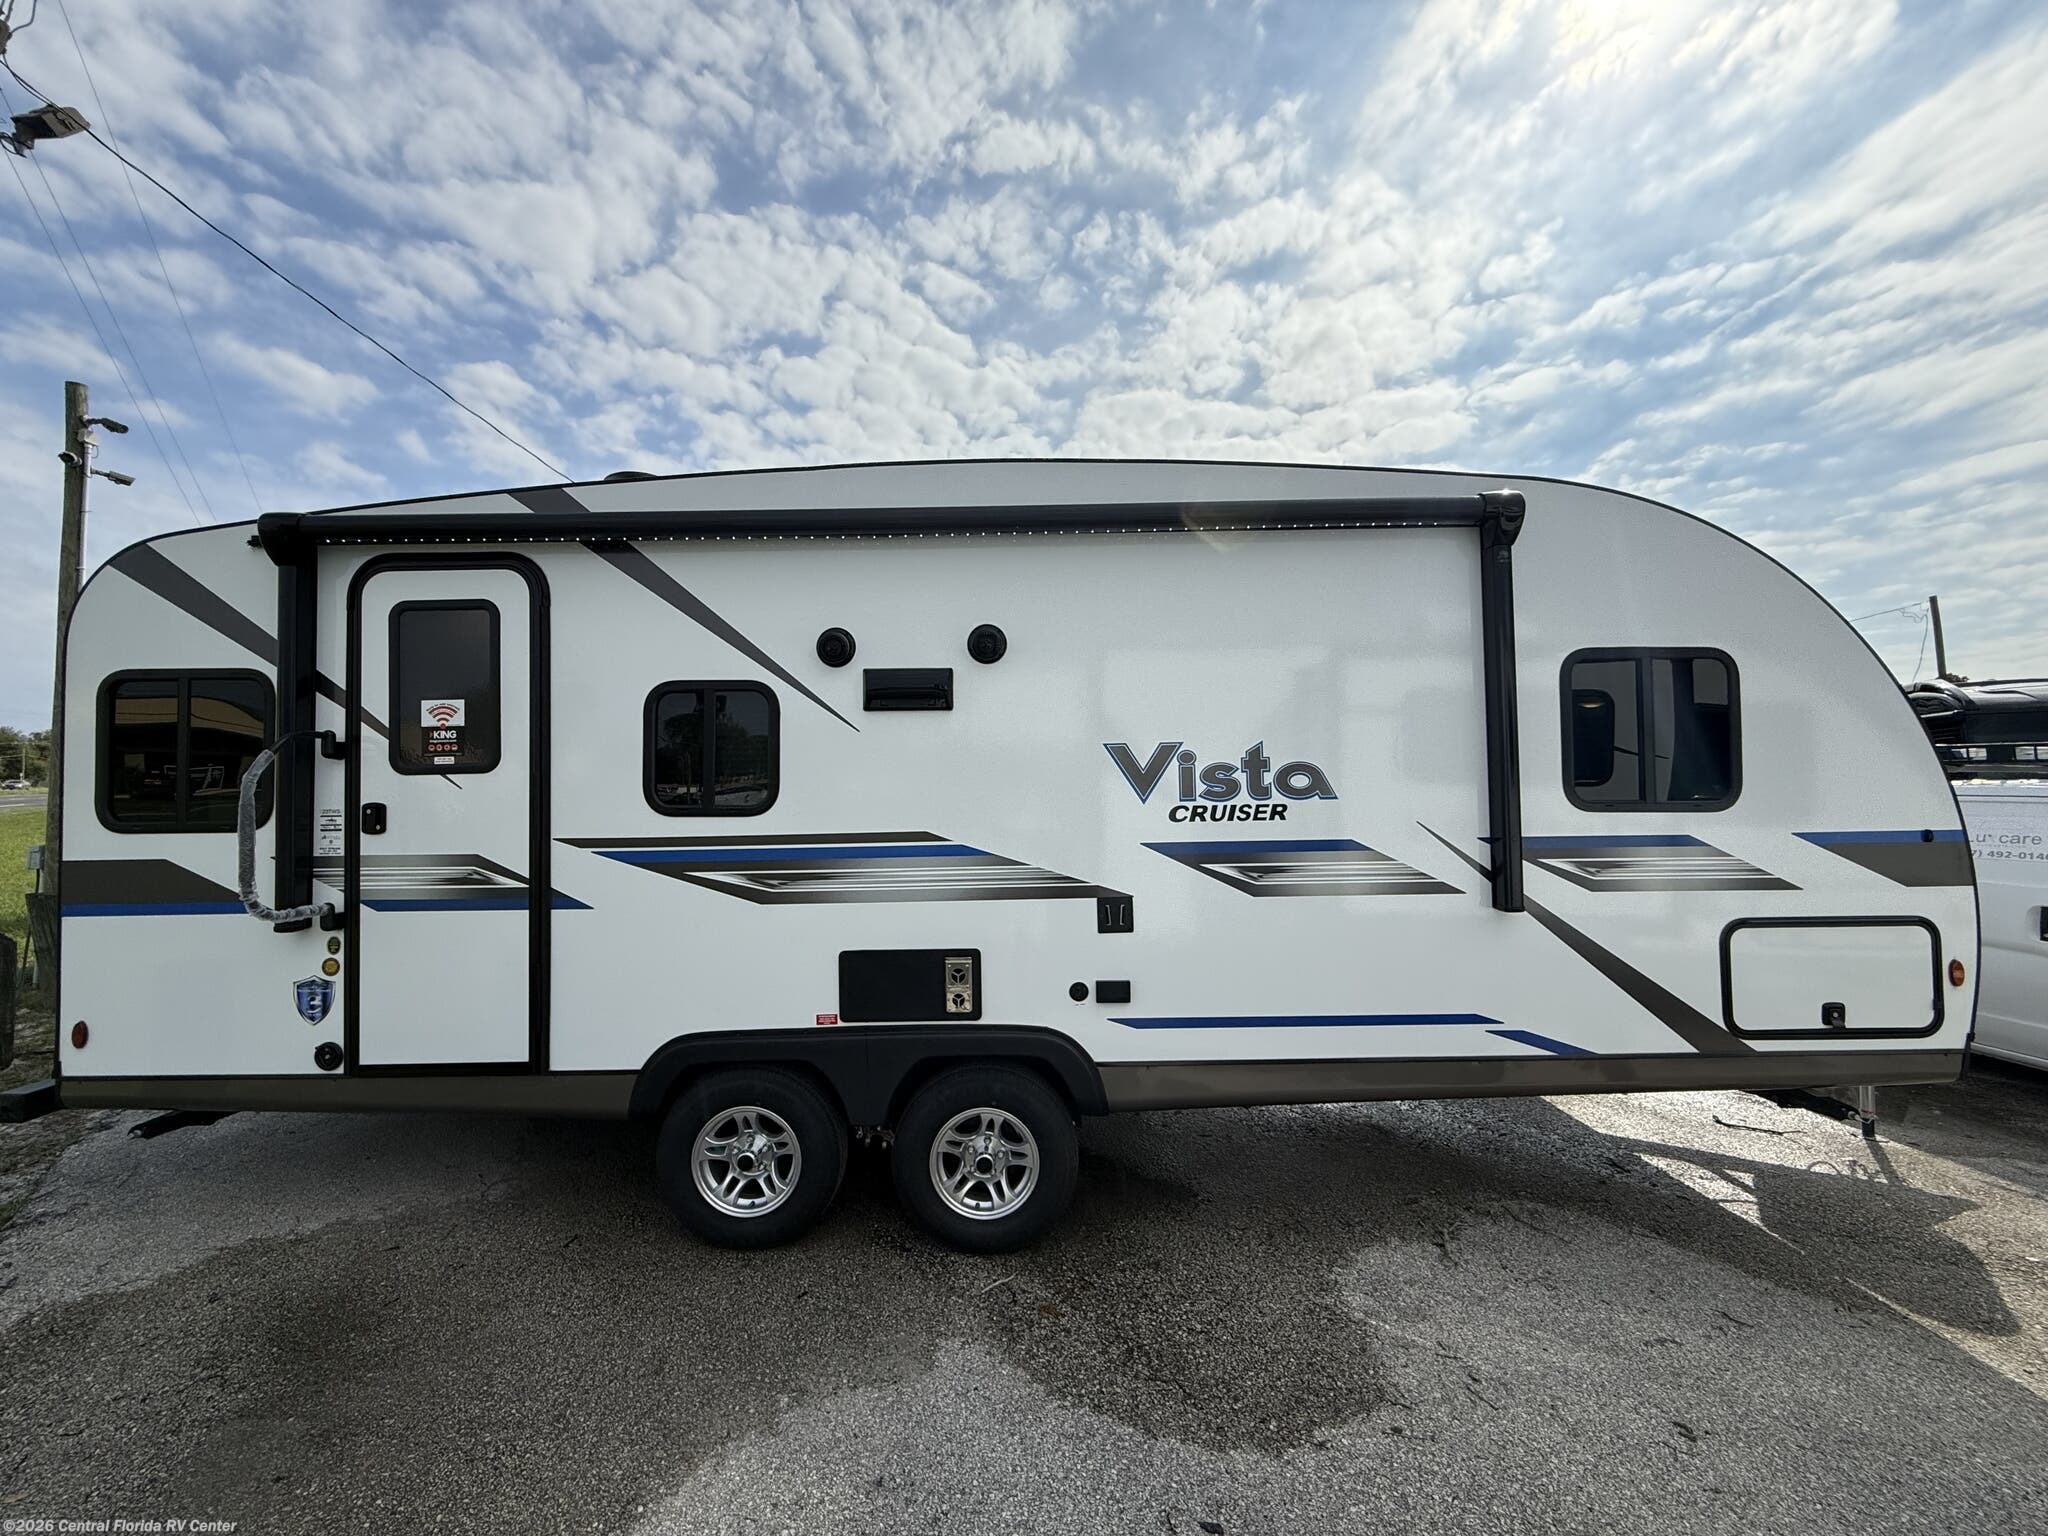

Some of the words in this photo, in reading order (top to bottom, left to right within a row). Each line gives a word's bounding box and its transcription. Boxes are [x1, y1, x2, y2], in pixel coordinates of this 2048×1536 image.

[433, 730, 457, 739] KING
[1102, 740, 1339, 805] Vista
[1168, 803, 1288, 823] CRUISER
[1998, 834, 2042, 845] care
